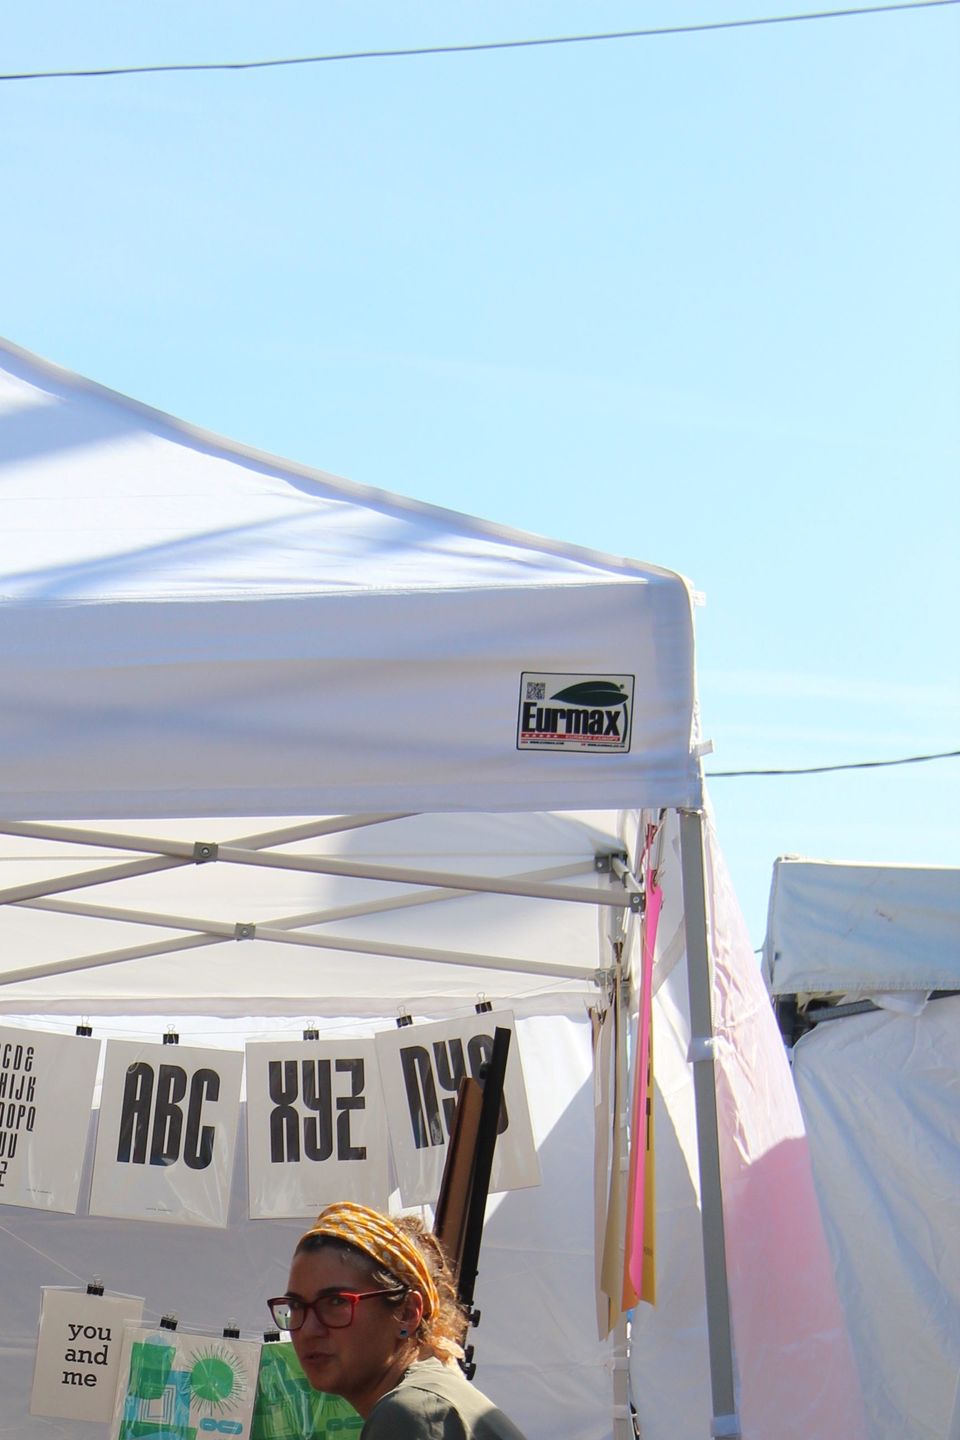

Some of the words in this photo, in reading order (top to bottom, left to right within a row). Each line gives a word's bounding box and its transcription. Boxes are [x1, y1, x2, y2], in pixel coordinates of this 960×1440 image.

[522, 701, 622, 736] Eurmax
[116, 1061, 220, 1170] ABC
[268, 1058, 367, 1163] XYZ
[68, 1322, 112, 1342] you
[64, 1345, 108, 1366] and
[61, 1368, 98, 1387] me
